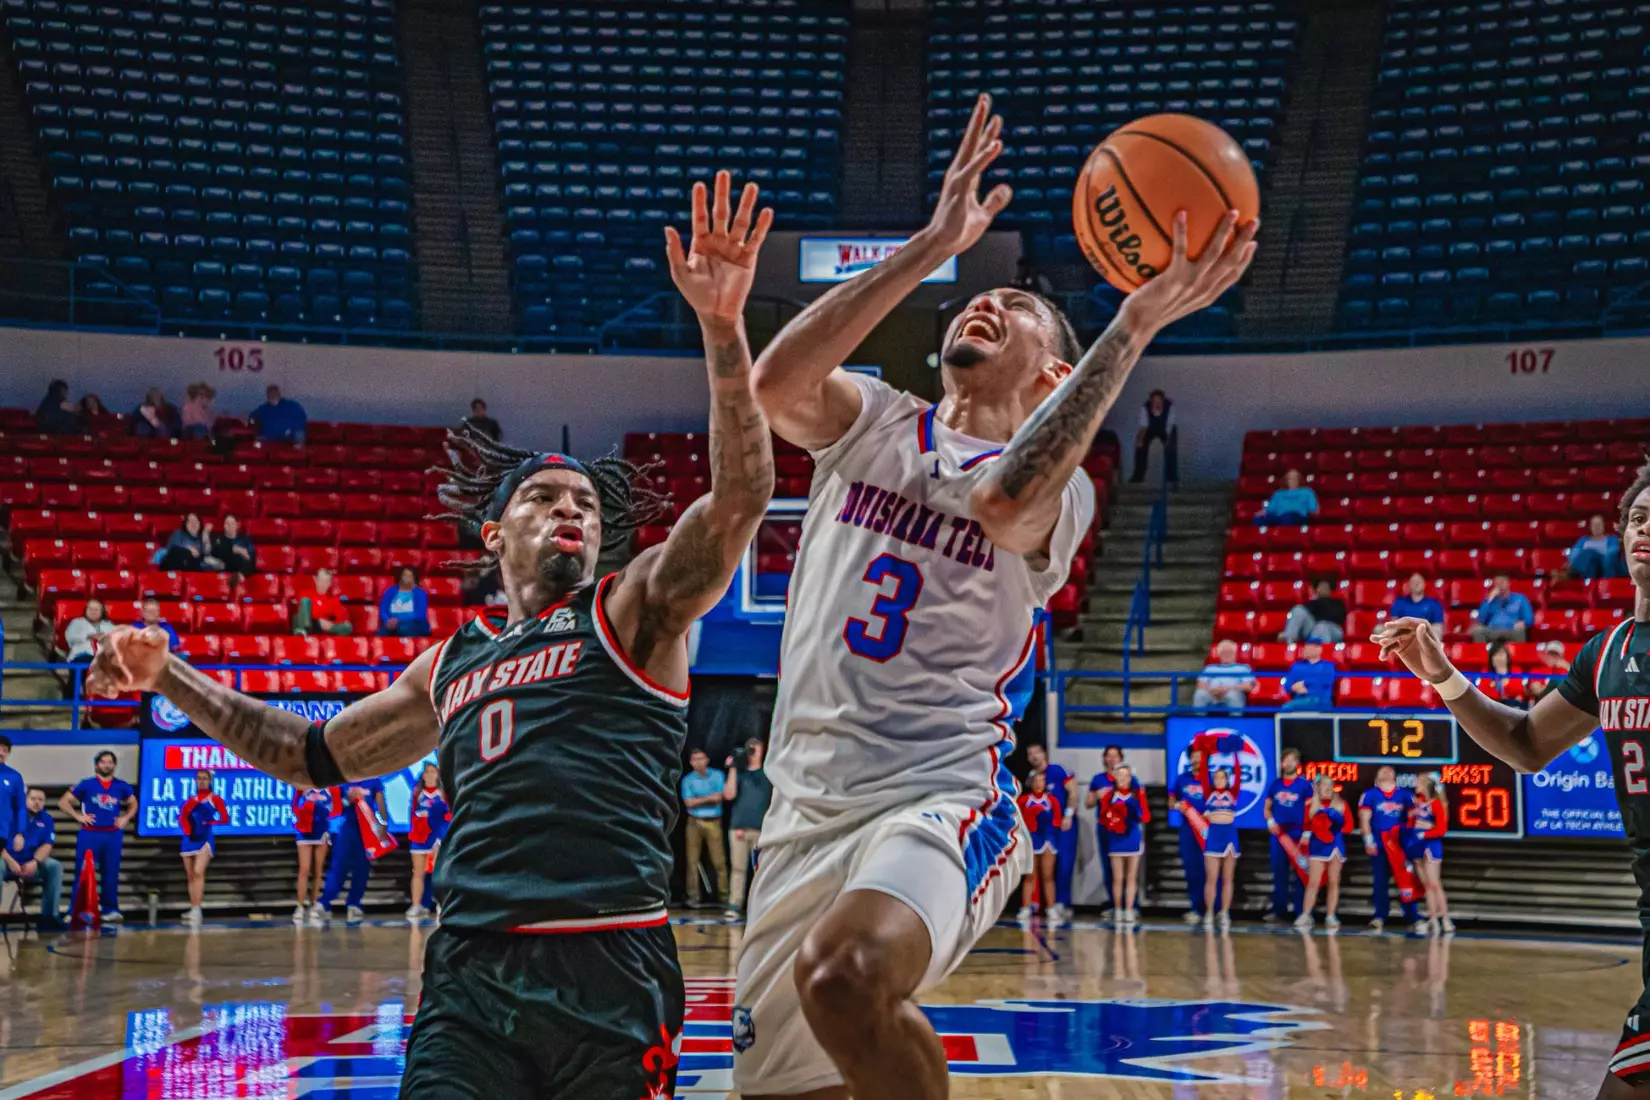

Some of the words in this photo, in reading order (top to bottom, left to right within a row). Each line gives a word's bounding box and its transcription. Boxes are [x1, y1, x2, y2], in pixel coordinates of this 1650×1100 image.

[1095, 184, 1160, 280] Wilso
[837, 244, 881, 266] WALK
[213, 346, 264, 372] 105
[1505, 347, 1556, 375] 107
[836, 480, 946, 550] OUISIANA
[842, 552, 924, 664] 3
[440, 663, 493, 724] JAX
[487, 639, 583, 692] STATE
[479, 698, 515, 762] 0
[1368, 719, 1425, 757] 7.2
[1533, 770, 1590, 792] Origin
[1595, 771, 1616, 789] Ba
[1621, 739, 1649, 795] 2
[152, 777, 176, 800] LA
[1459, 787, 1510, 827] 20
[1534, 820, 1548, 829] OF
[1593, 822, 1622, 832] ATHLE
